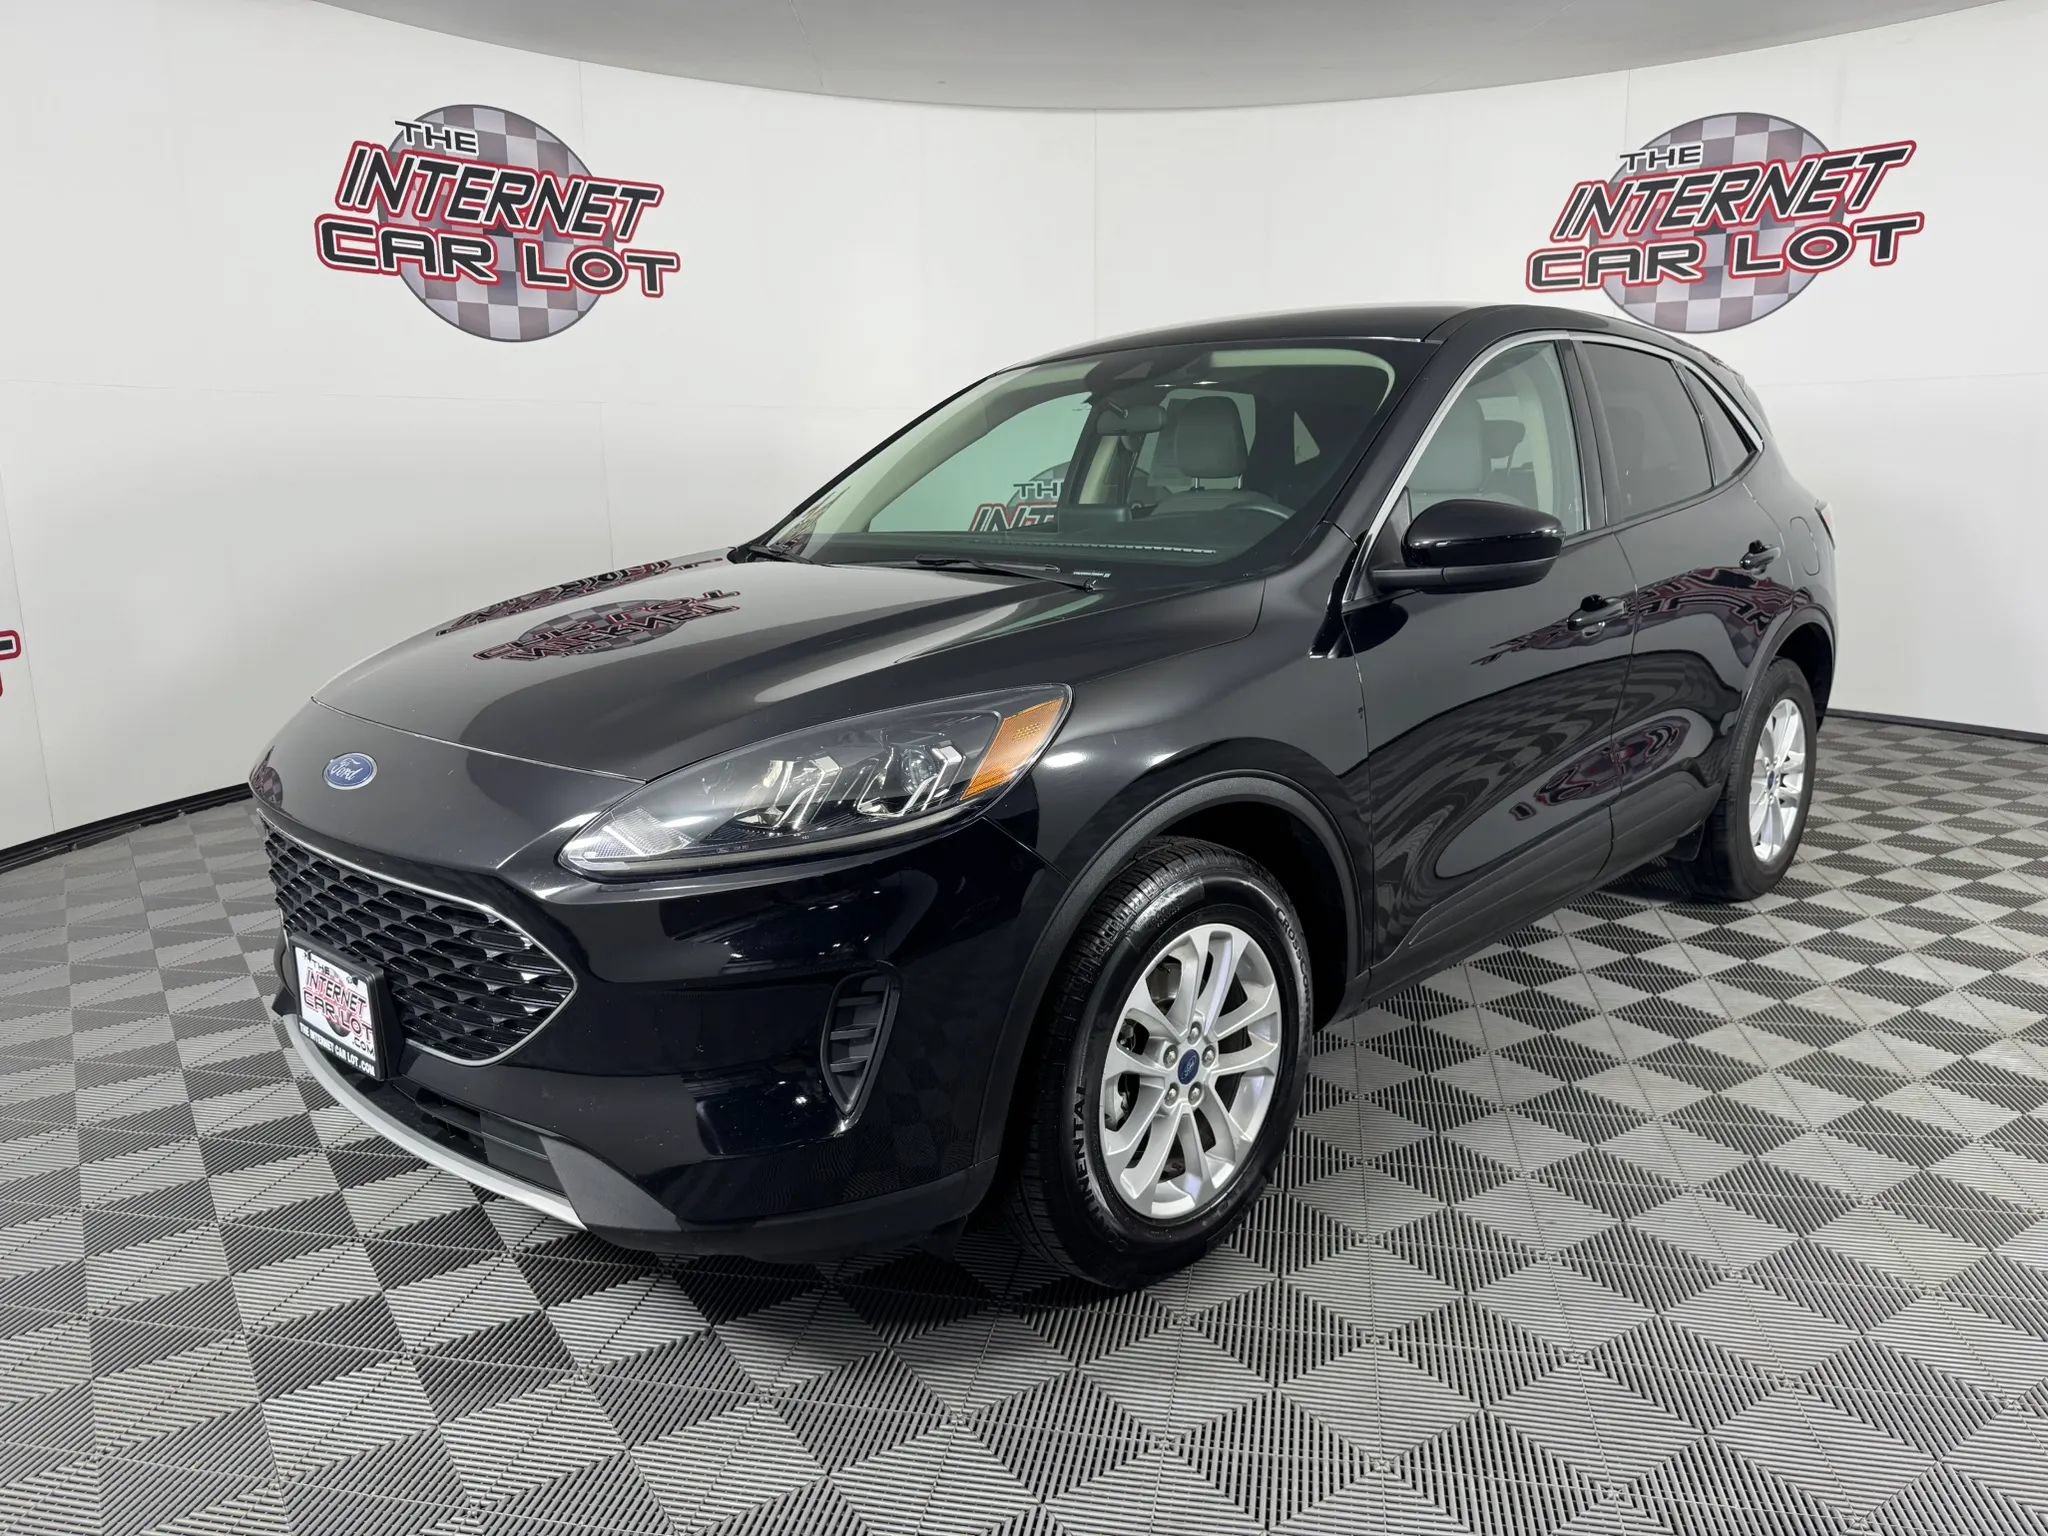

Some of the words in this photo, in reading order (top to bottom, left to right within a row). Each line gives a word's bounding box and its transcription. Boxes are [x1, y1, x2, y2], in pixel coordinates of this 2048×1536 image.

[394, 120, 478, 154] THE
[1620, 144, 1703, 172] THE
[337, 146, 661, 240] INTERNET
[1554, 145, 1911, 239] INTERNET
[320, 220, 498, 281] CAR
[522, 243, 678, 294] LOT
[1530, 242, 1703, 288] CAR
[1733, 217, 1921, 273] LOT
[1013, 481, 1063, 499] TH
[330, 757, 364, 781] Ford
[311, 959, 330, 976] THE
[303, 990, 338, 1022] CAR
[341, 1009, 373, 1041] LOT
[306, 968, 366, 1016] INTERNET
